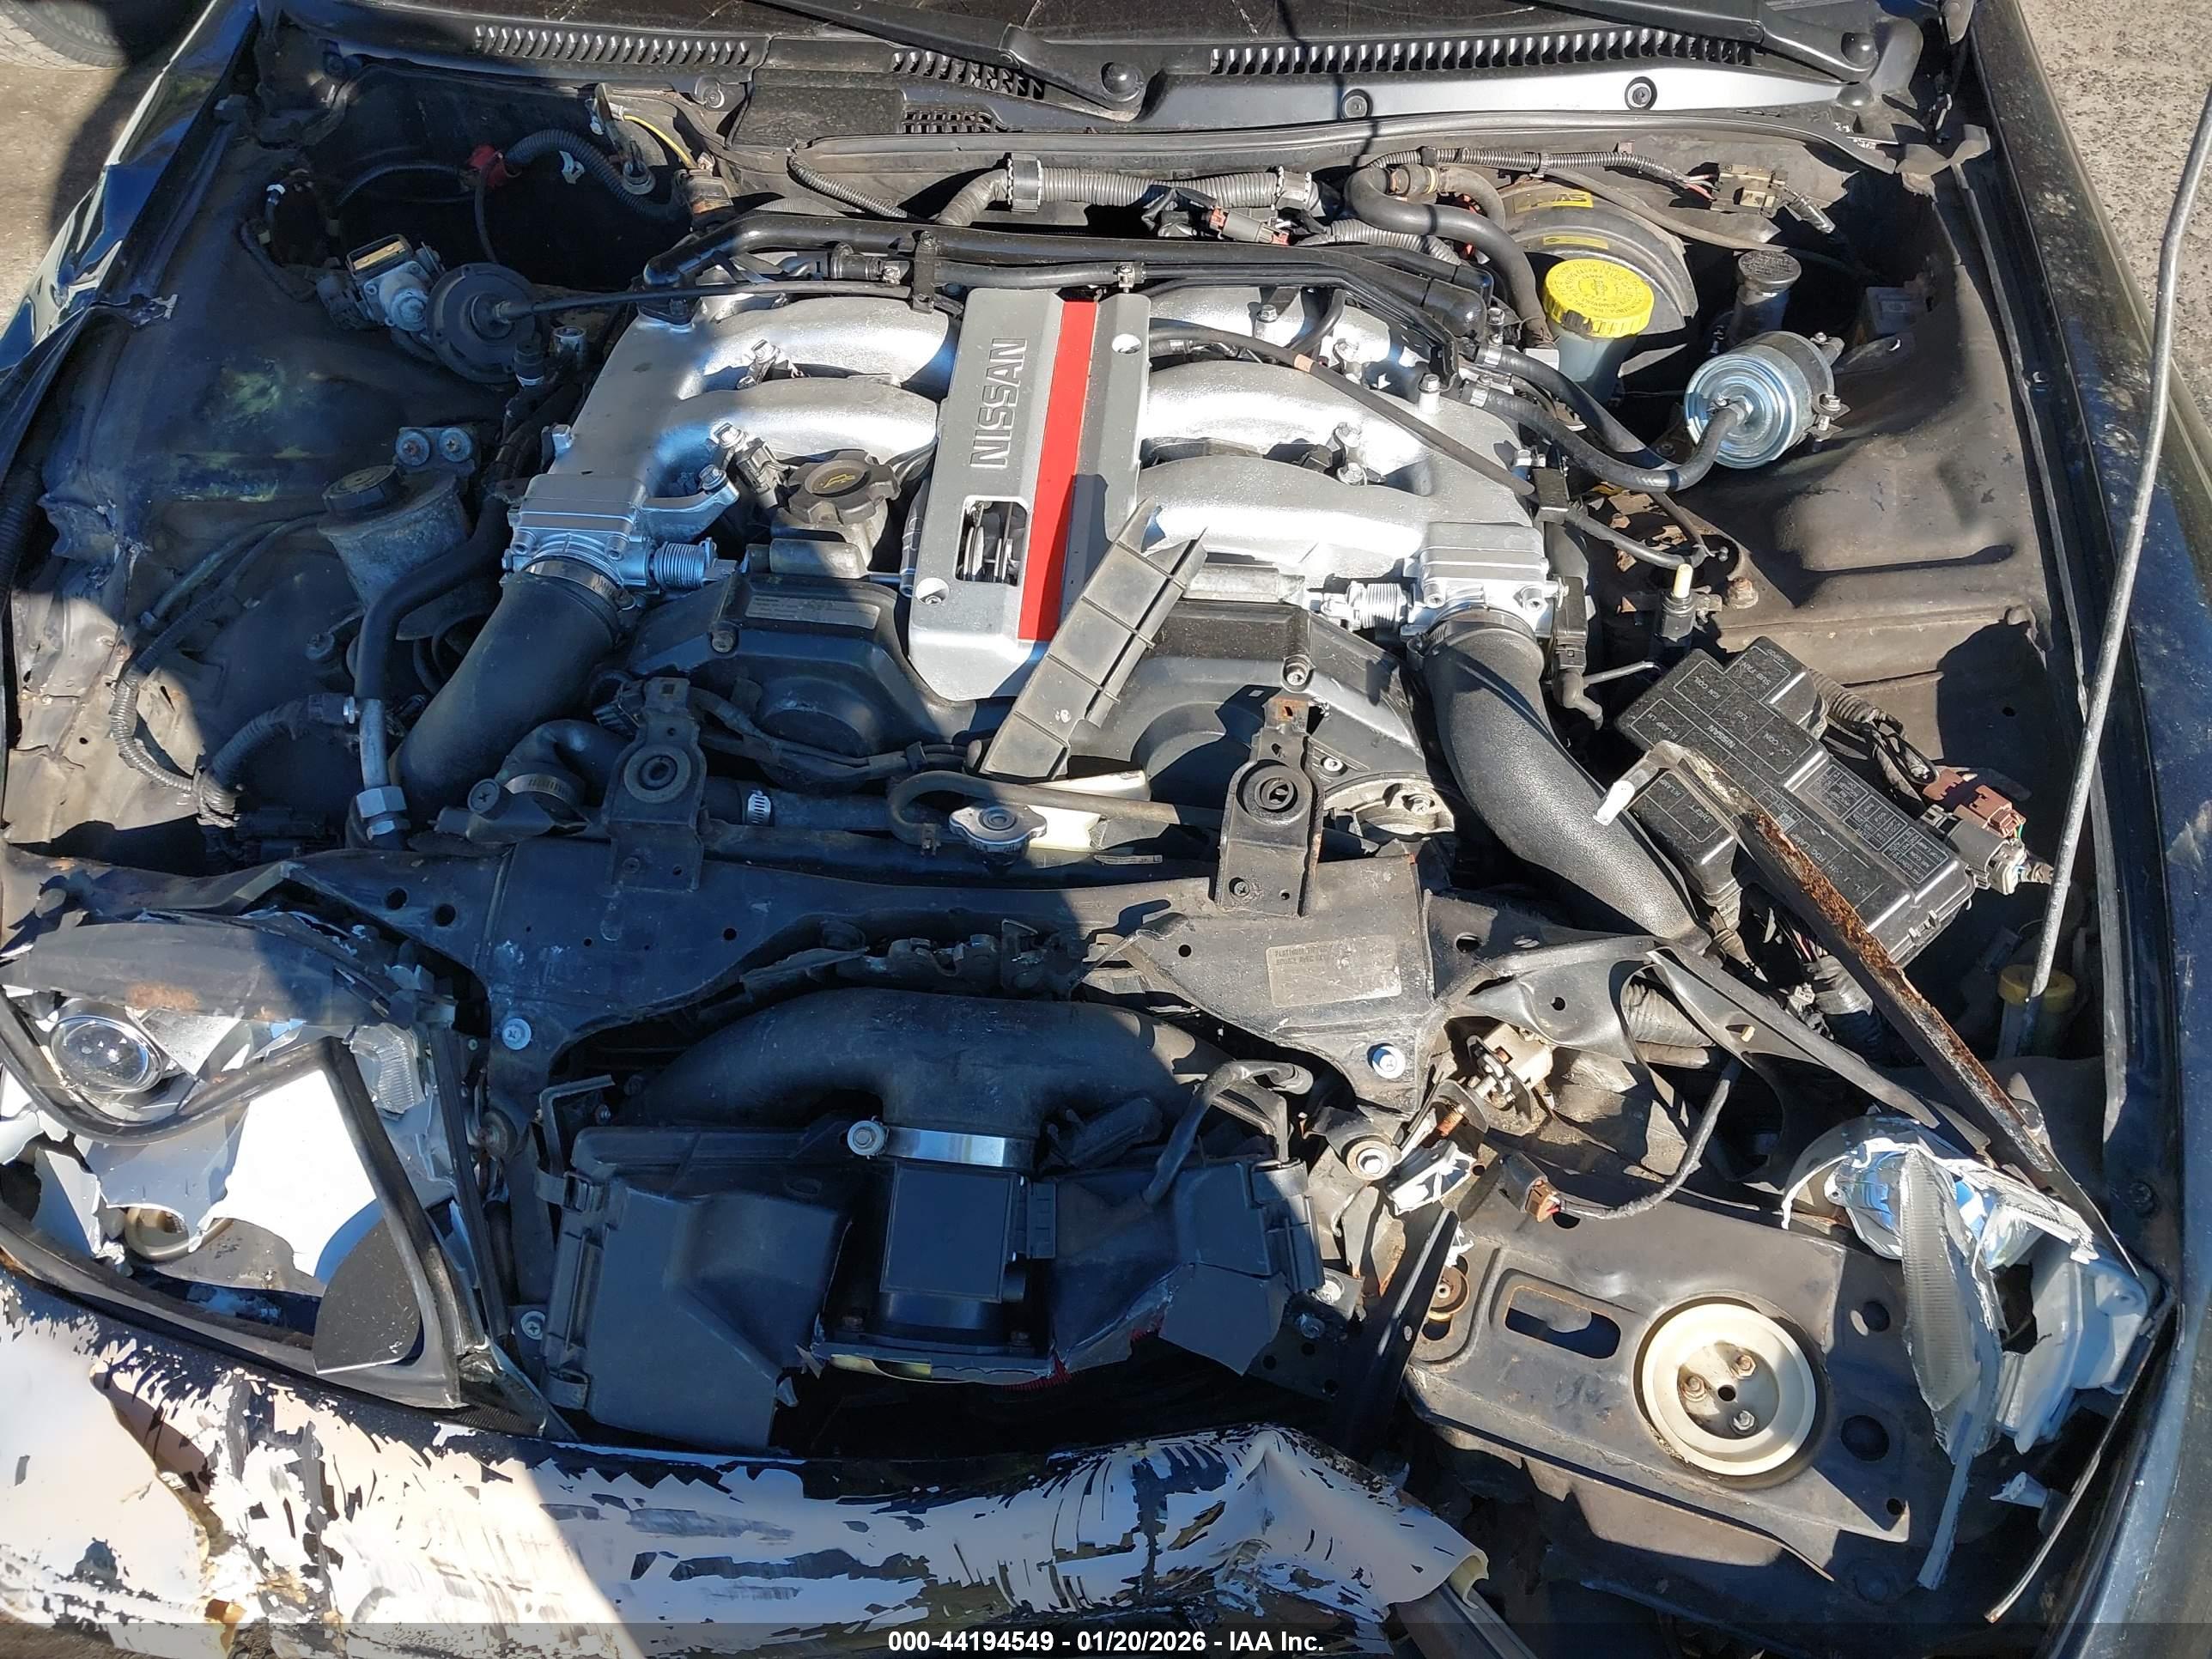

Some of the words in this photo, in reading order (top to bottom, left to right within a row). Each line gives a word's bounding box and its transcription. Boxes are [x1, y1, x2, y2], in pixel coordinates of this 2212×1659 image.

[969, 337, 1027, 469] NISSAN
[1741, 659, 1755, 674] FAN
[1692, 676, 1708, 690] COIL
[1755, 672, 1771, 686] SUB
[1707, 687, 1721, 699] IGN
[1646, 711, 1656, 721] LH
[1735, 708, 1748, 721] EGI
[1705, 722, 1735, 749] NISSAN
[1687, 802, 1711, 823] THEFT
[1789, 830, 1810, 849] LAMP
[1809, 848, 1826, 862] FOG
